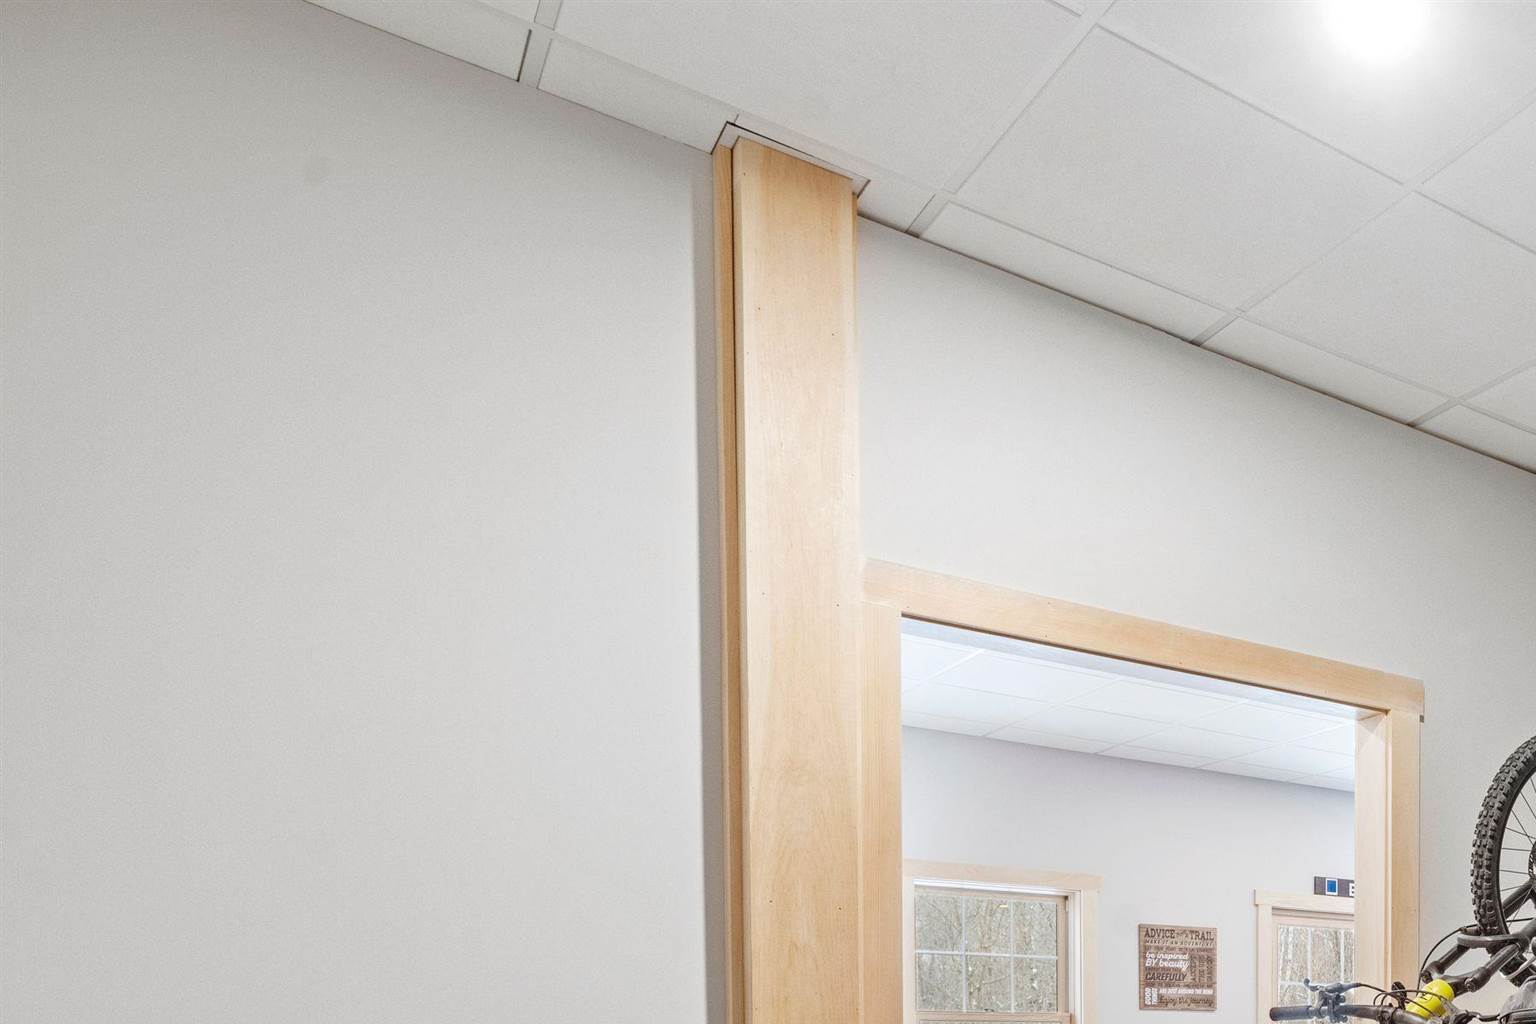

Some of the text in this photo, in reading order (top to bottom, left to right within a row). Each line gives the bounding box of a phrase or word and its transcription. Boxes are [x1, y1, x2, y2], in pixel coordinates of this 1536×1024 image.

[1145, 928, 1176, 939] ADVICE
[1189, 930, 1214, 940] TRAIL
[1156, 952, 1189, 961] inspired
[1145, 959, 1157, 967] BY
[1159, 959, 1189, 972] beauty
[1145, 972, 1187, 981] CAREFULLY
